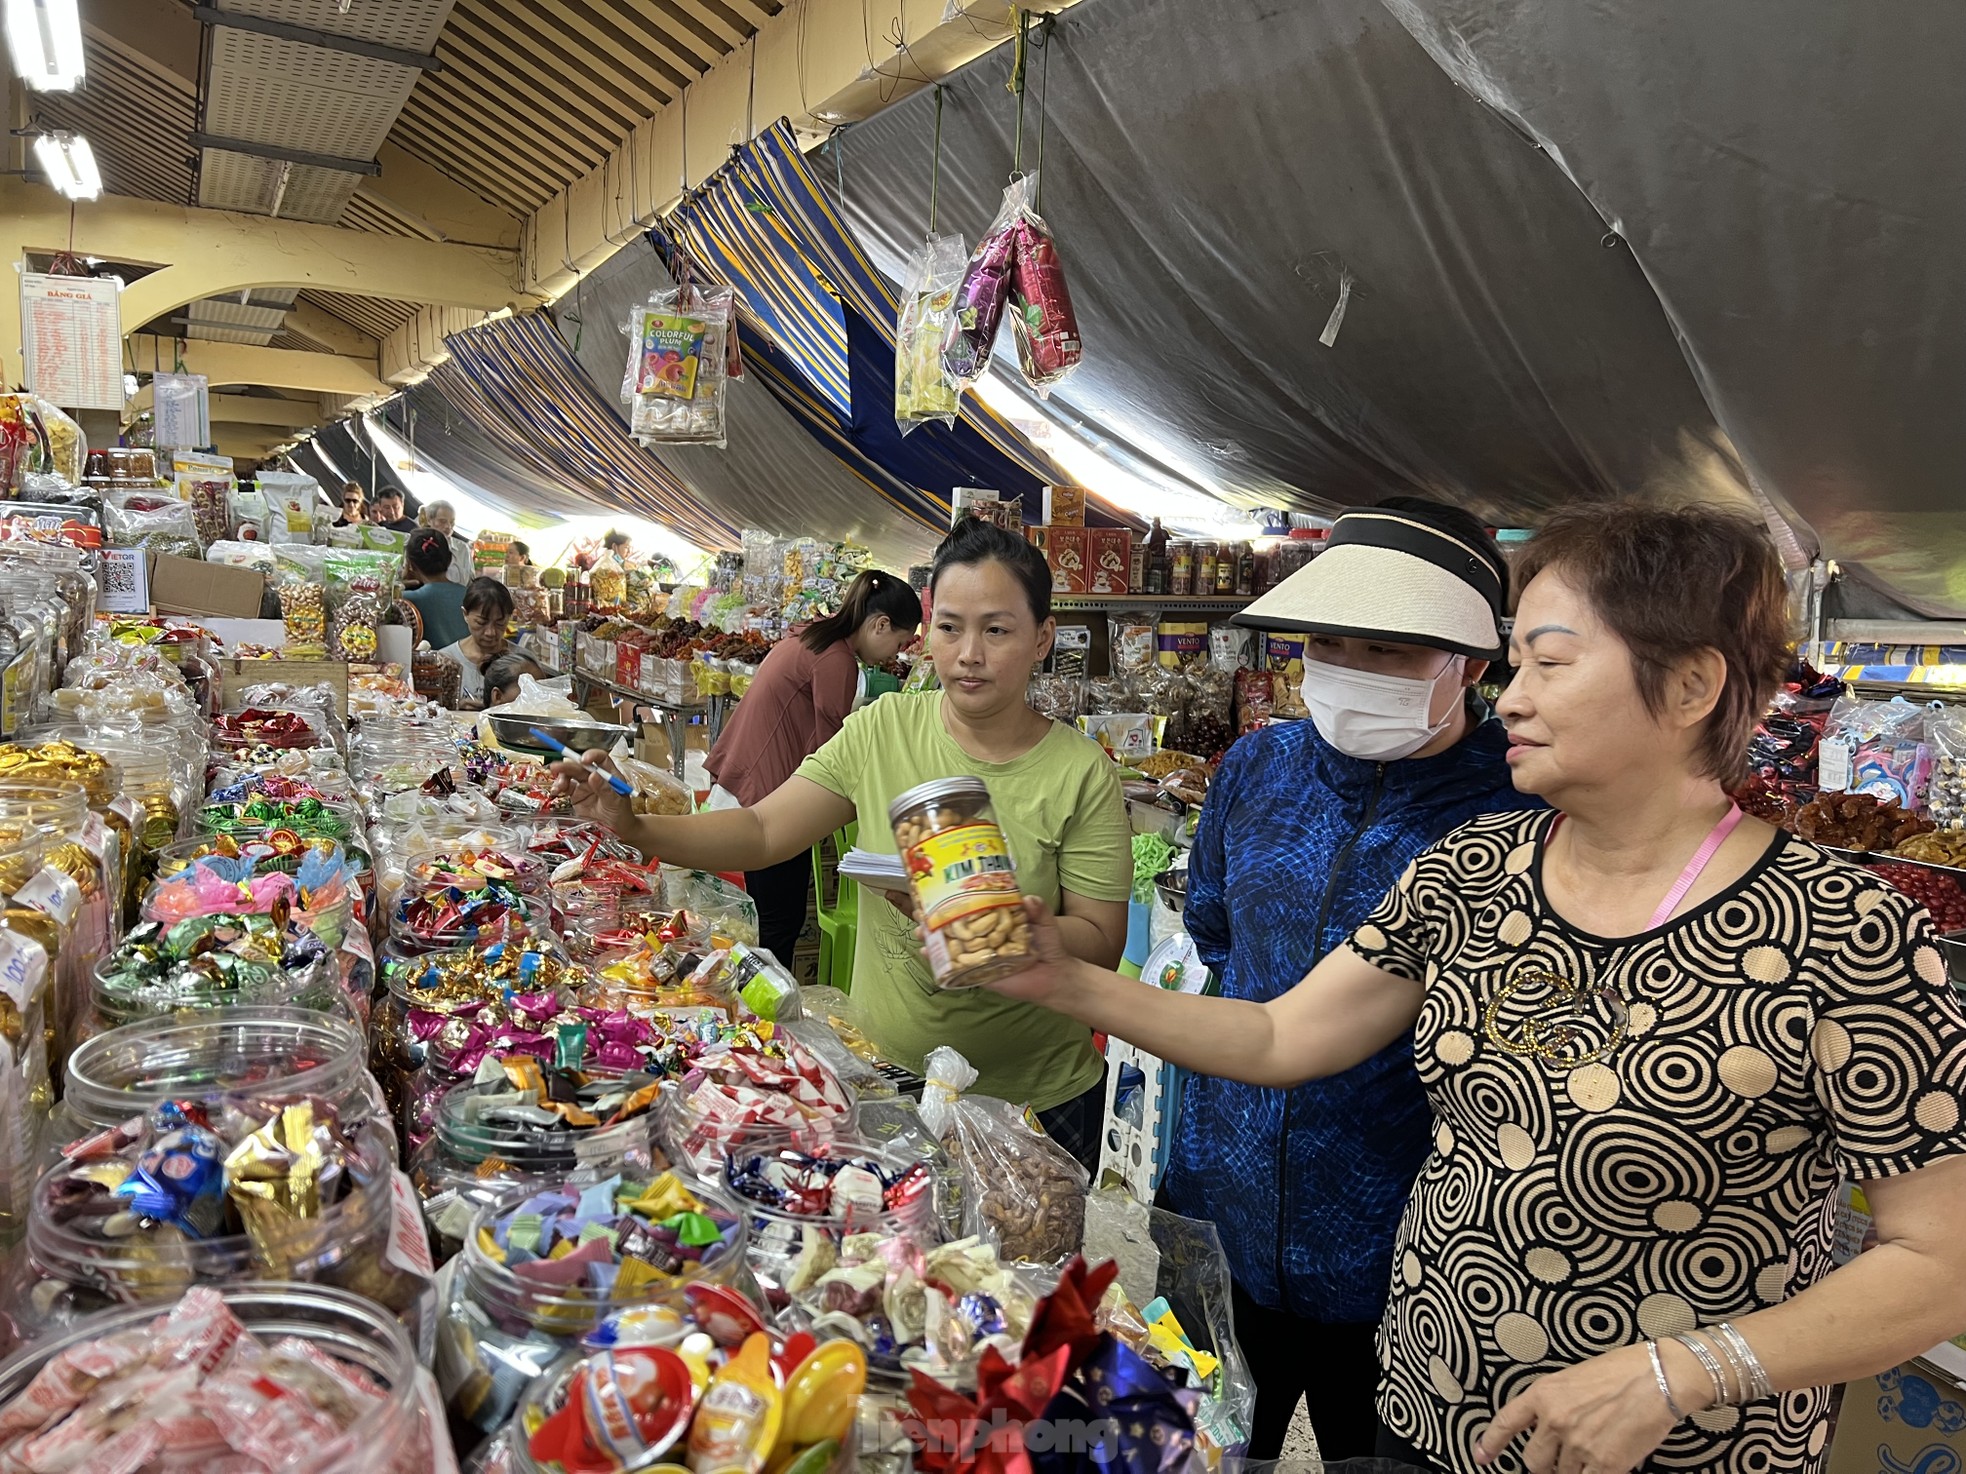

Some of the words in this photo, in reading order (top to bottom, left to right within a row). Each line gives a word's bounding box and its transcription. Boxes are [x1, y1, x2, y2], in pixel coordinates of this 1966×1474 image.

[649, 329, 695, 342] COLORFUL
[659, 338, 682, 346] PLUM
[101, 550, 135, 560] VIETQR
[1177, 638, 1200, 646] VENTO
[1269, 642, 1291, 651] VENTO
